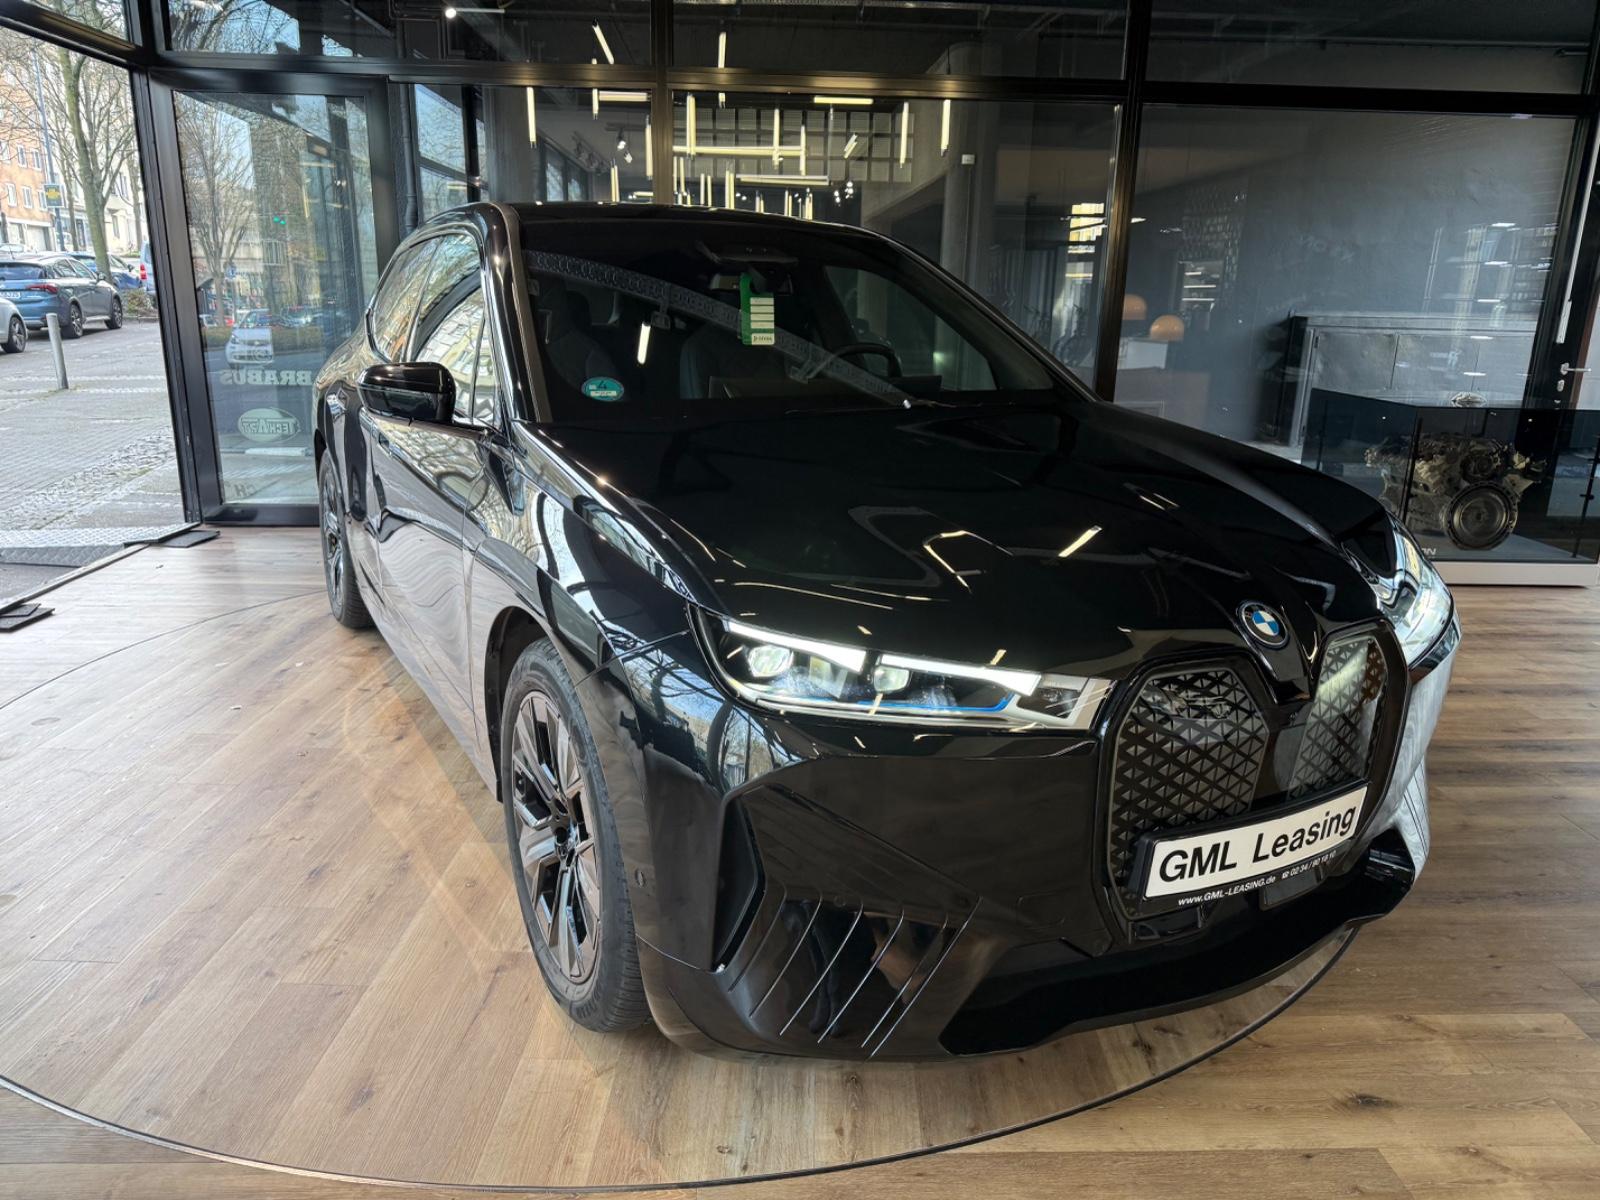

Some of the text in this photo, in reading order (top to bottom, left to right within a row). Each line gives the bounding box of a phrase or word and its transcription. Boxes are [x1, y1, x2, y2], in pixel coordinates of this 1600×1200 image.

[1159, 805, 1358, 883] GML Leasing
[1178, 875, 1277, 906] www.GML-LEASING.de
